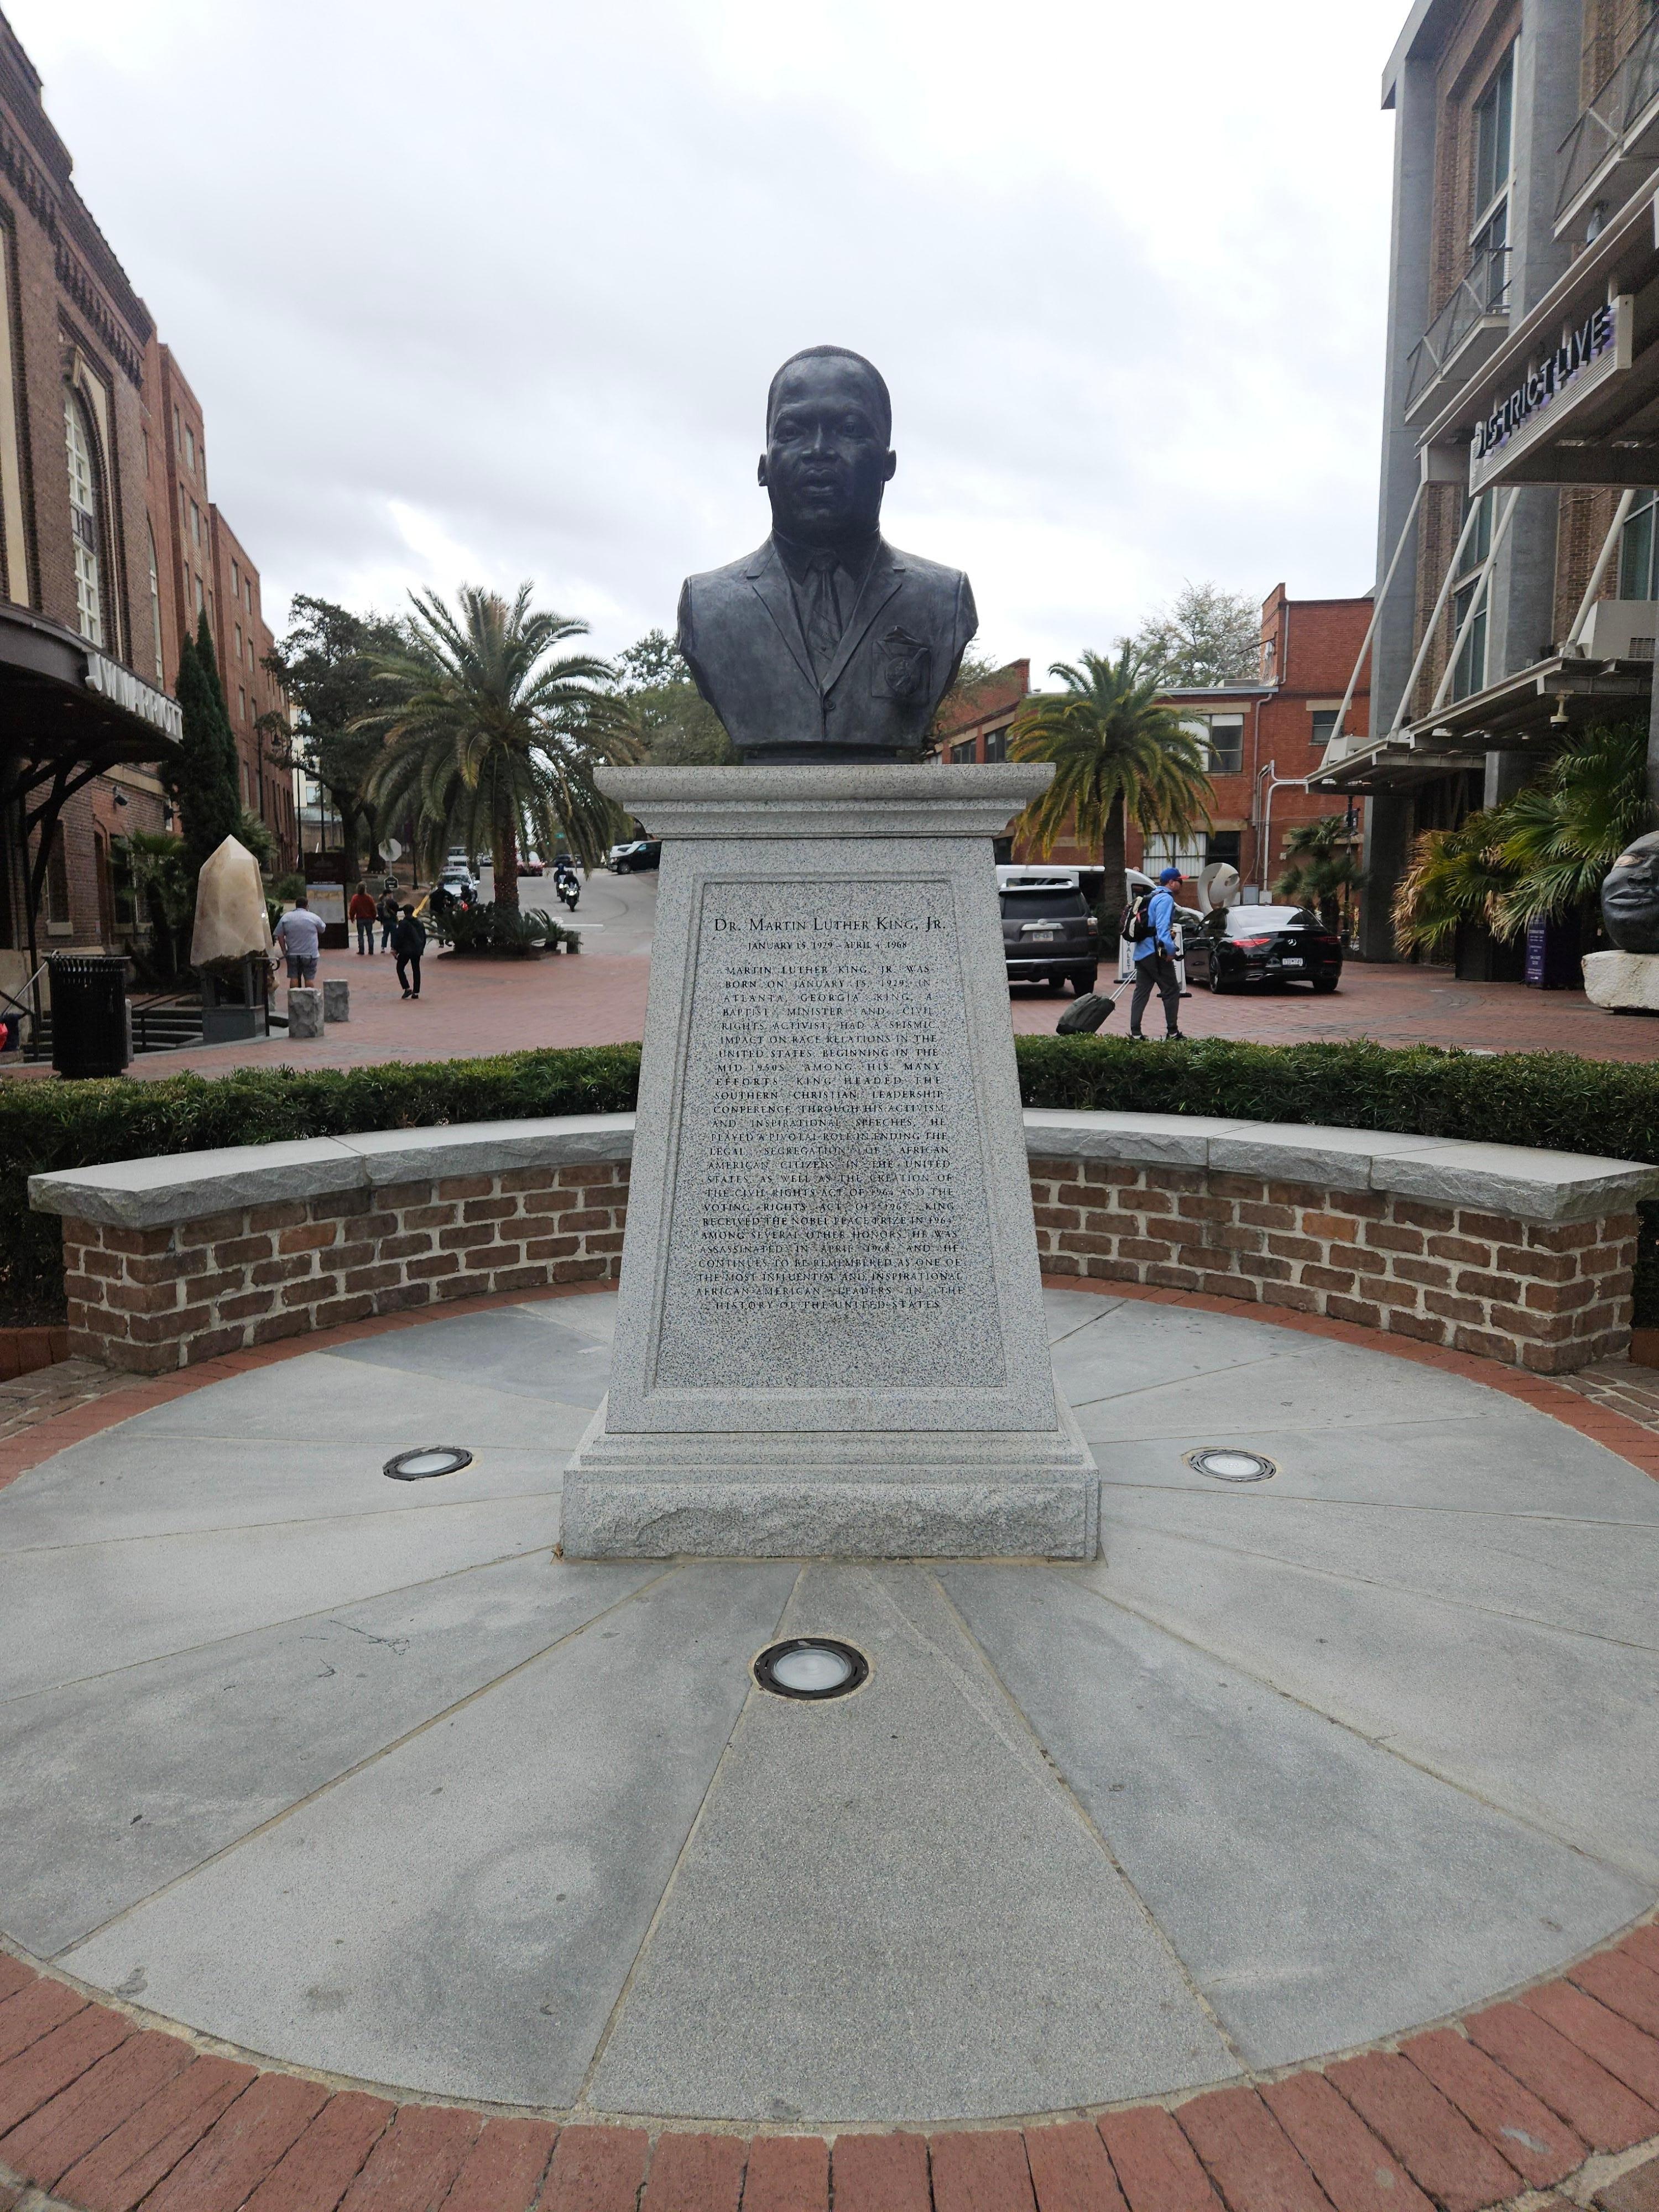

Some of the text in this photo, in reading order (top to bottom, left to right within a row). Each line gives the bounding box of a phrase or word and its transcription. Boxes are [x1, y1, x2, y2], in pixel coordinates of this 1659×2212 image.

[1474, 306, 1605, 459] DISTRICT LIVE
[85, 652, 116, 701] JW
[750, 918, 806, 931] MARTIN
[813, 917, 869, 931] LUTHER
[748, 942, 792, 951] JANUARY
[726, 966, 771, 974] MARTIN
[793, 980, 844, 989] JANUARY
[723, 1008, 768, 1016] BAPTIST
[787, 1008, 843, 1016] MINISTER
[721, 1036, 764, 1044] IMPACT
[823, 1049, 888, 1057] BEGINNING
[805, 1063, 852, 1072] AMONG
[703, 1218, 760, 1226] RECEIVED
[700, 1245, 783, 1254] ASSASSINATED
[699, 1259, 767, 1267] CONTINUES
[814, 1259, 892, 1267] REMEMBERED
[763, 1273, 835, 1281] INFLUENTIAL
[872, 1272, 963, 1281] INSPIRATIONAL
[717, 1301, 773, 1310] HISTORY
